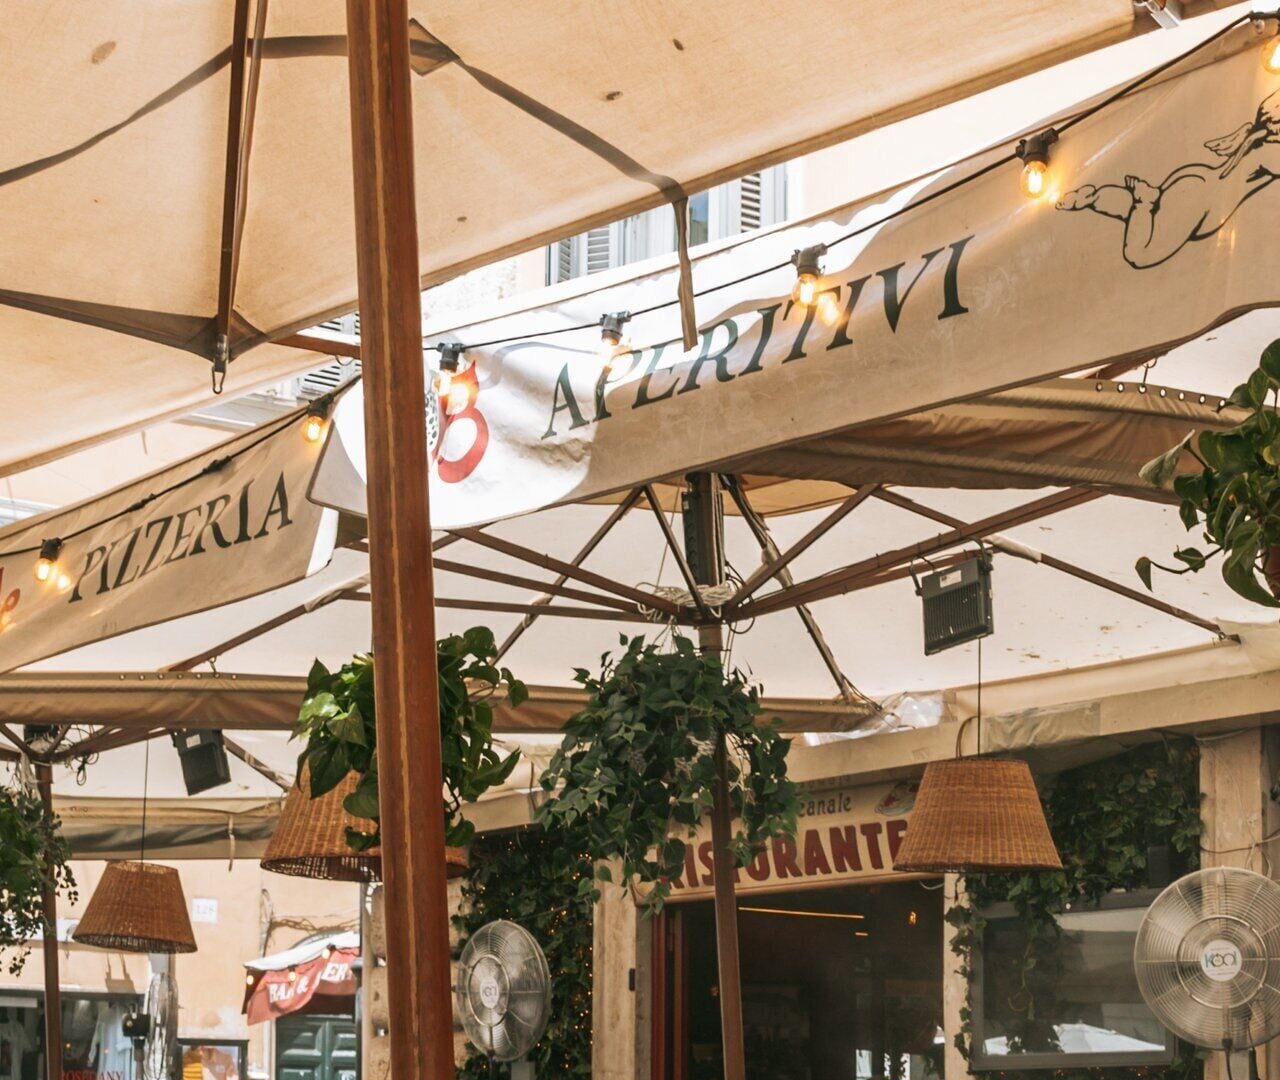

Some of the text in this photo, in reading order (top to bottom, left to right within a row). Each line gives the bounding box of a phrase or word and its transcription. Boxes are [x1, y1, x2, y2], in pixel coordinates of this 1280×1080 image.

[541, 233, 971, 440] APERITIVI
[68, 470, 293, 604] PIZZERIA
[661, 819, 908, 891] ISORANTE
[797, 792, 852, 818] canale
